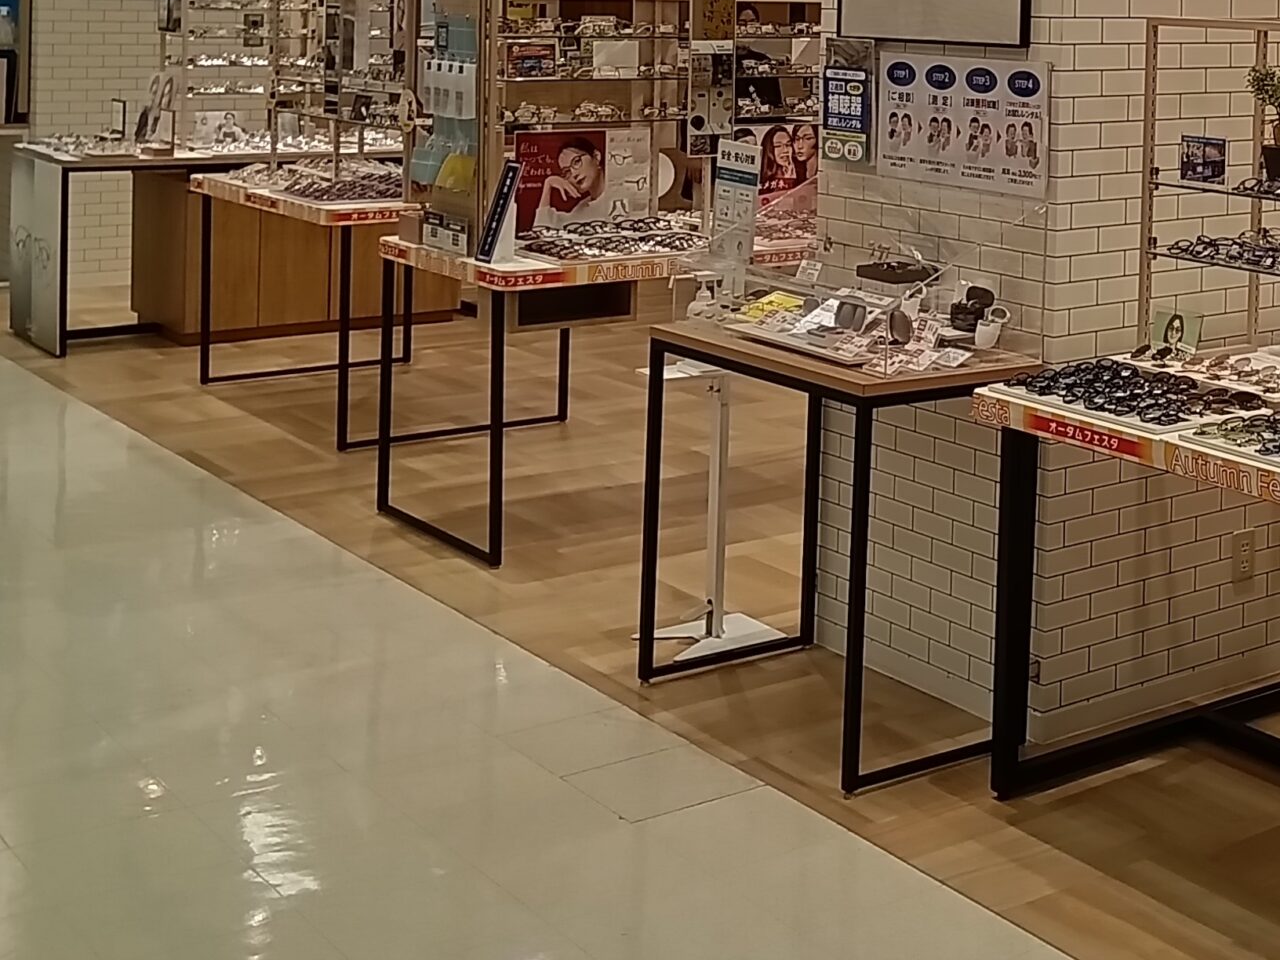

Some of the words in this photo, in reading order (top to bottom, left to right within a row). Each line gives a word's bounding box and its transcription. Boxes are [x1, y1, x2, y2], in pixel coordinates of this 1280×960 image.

[827, 94, 862, 116] 補聴器
[592, 263, 662, 281] Autumn
[1048, 420, 1119, 450] オータムフェスタ
[1170, 446, 1252, 492] Autumn
